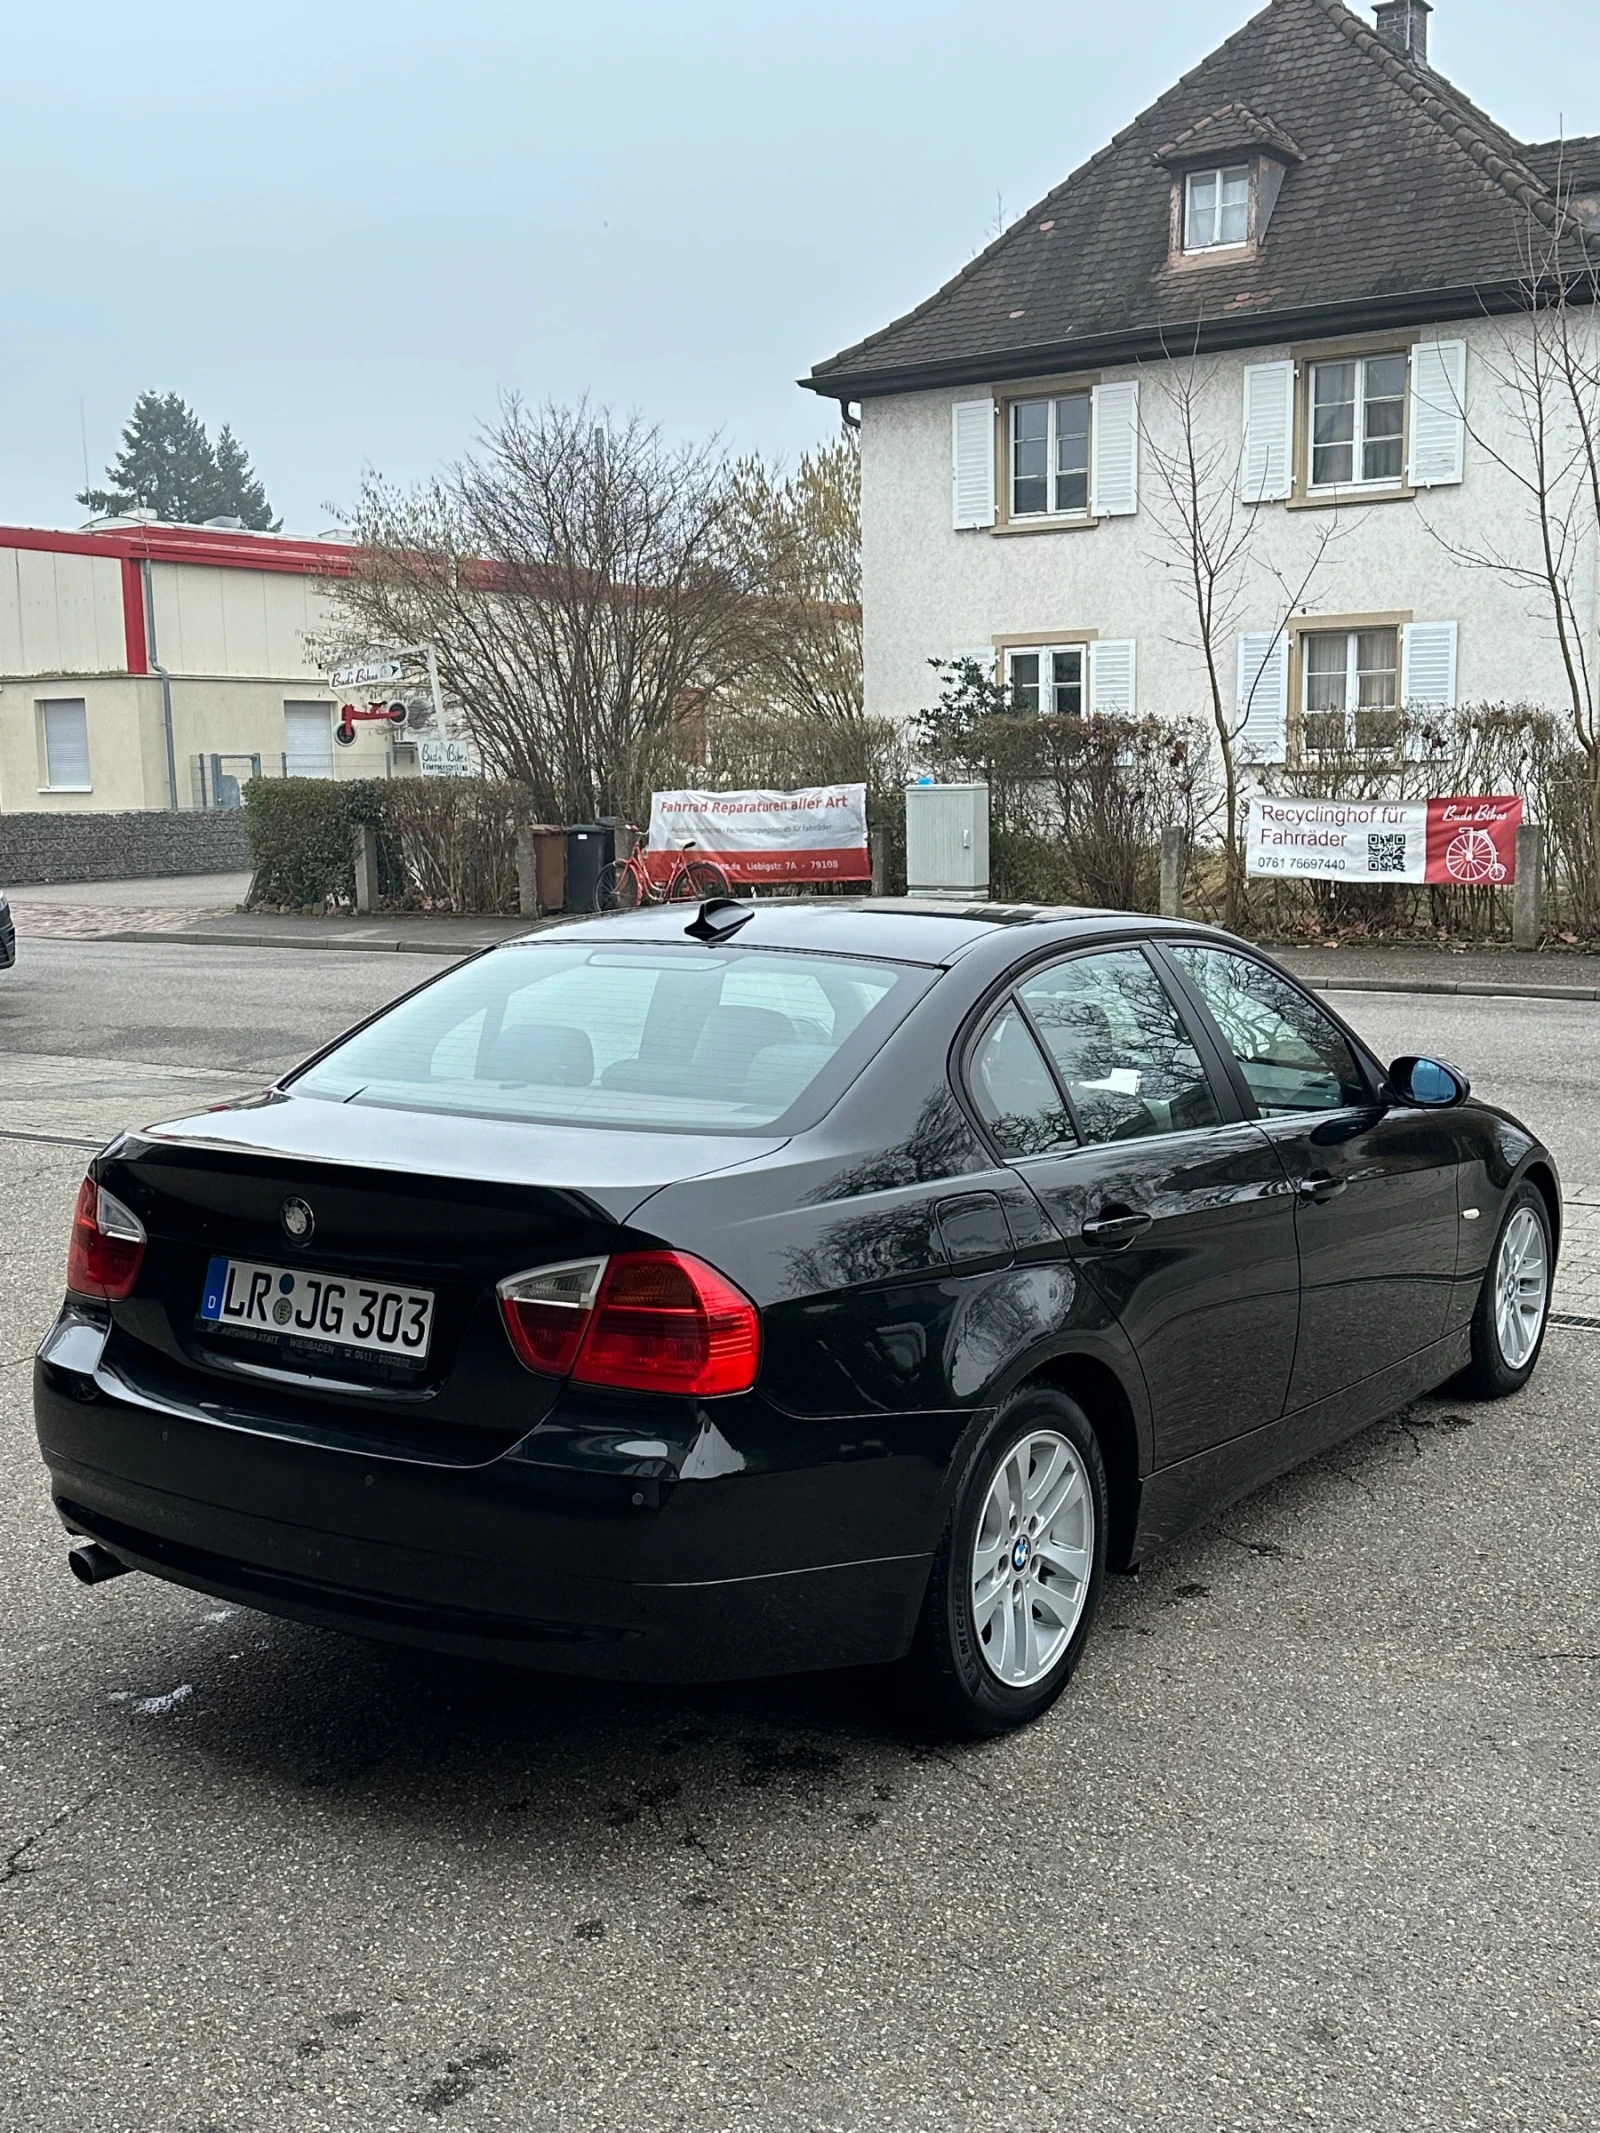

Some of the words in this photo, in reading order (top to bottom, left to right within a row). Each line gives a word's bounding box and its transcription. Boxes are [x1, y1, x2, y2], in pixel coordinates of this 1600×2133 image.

[356, 669, 379, 683] Bikes
[446, 744, 468, 763] Bikes
[661, 801, 708, 813] Fahrrad
[711, 799, 787, 816] Reparaturen
[791, 797, 822, 810] aller
[825, 795, 848, 809] Art
[1473, 804, 1507, 821] Bikes
[1262, 804, 1378, 826] Recyclinghof
[1381, 806, 1407, 824] für
[1260, 829, 1348, 847] Fahrräder
[746, 862, 783, 873] Liebigstr.
[785, 861, 797, 870] 7A
[810, 860, 839, 869] 79108
[1258, 857, 1286, 868] 0761
[1289, 858, 1346, 870] 76697440
[207, 1296, 217, 1309] D
[223, 1267, 273, 1322] LR
[294, 1280, 346, 1334] JG
[352, 1288, 429, 1347] 303
[289, 1338, 335, 1355] WIESBADEN
